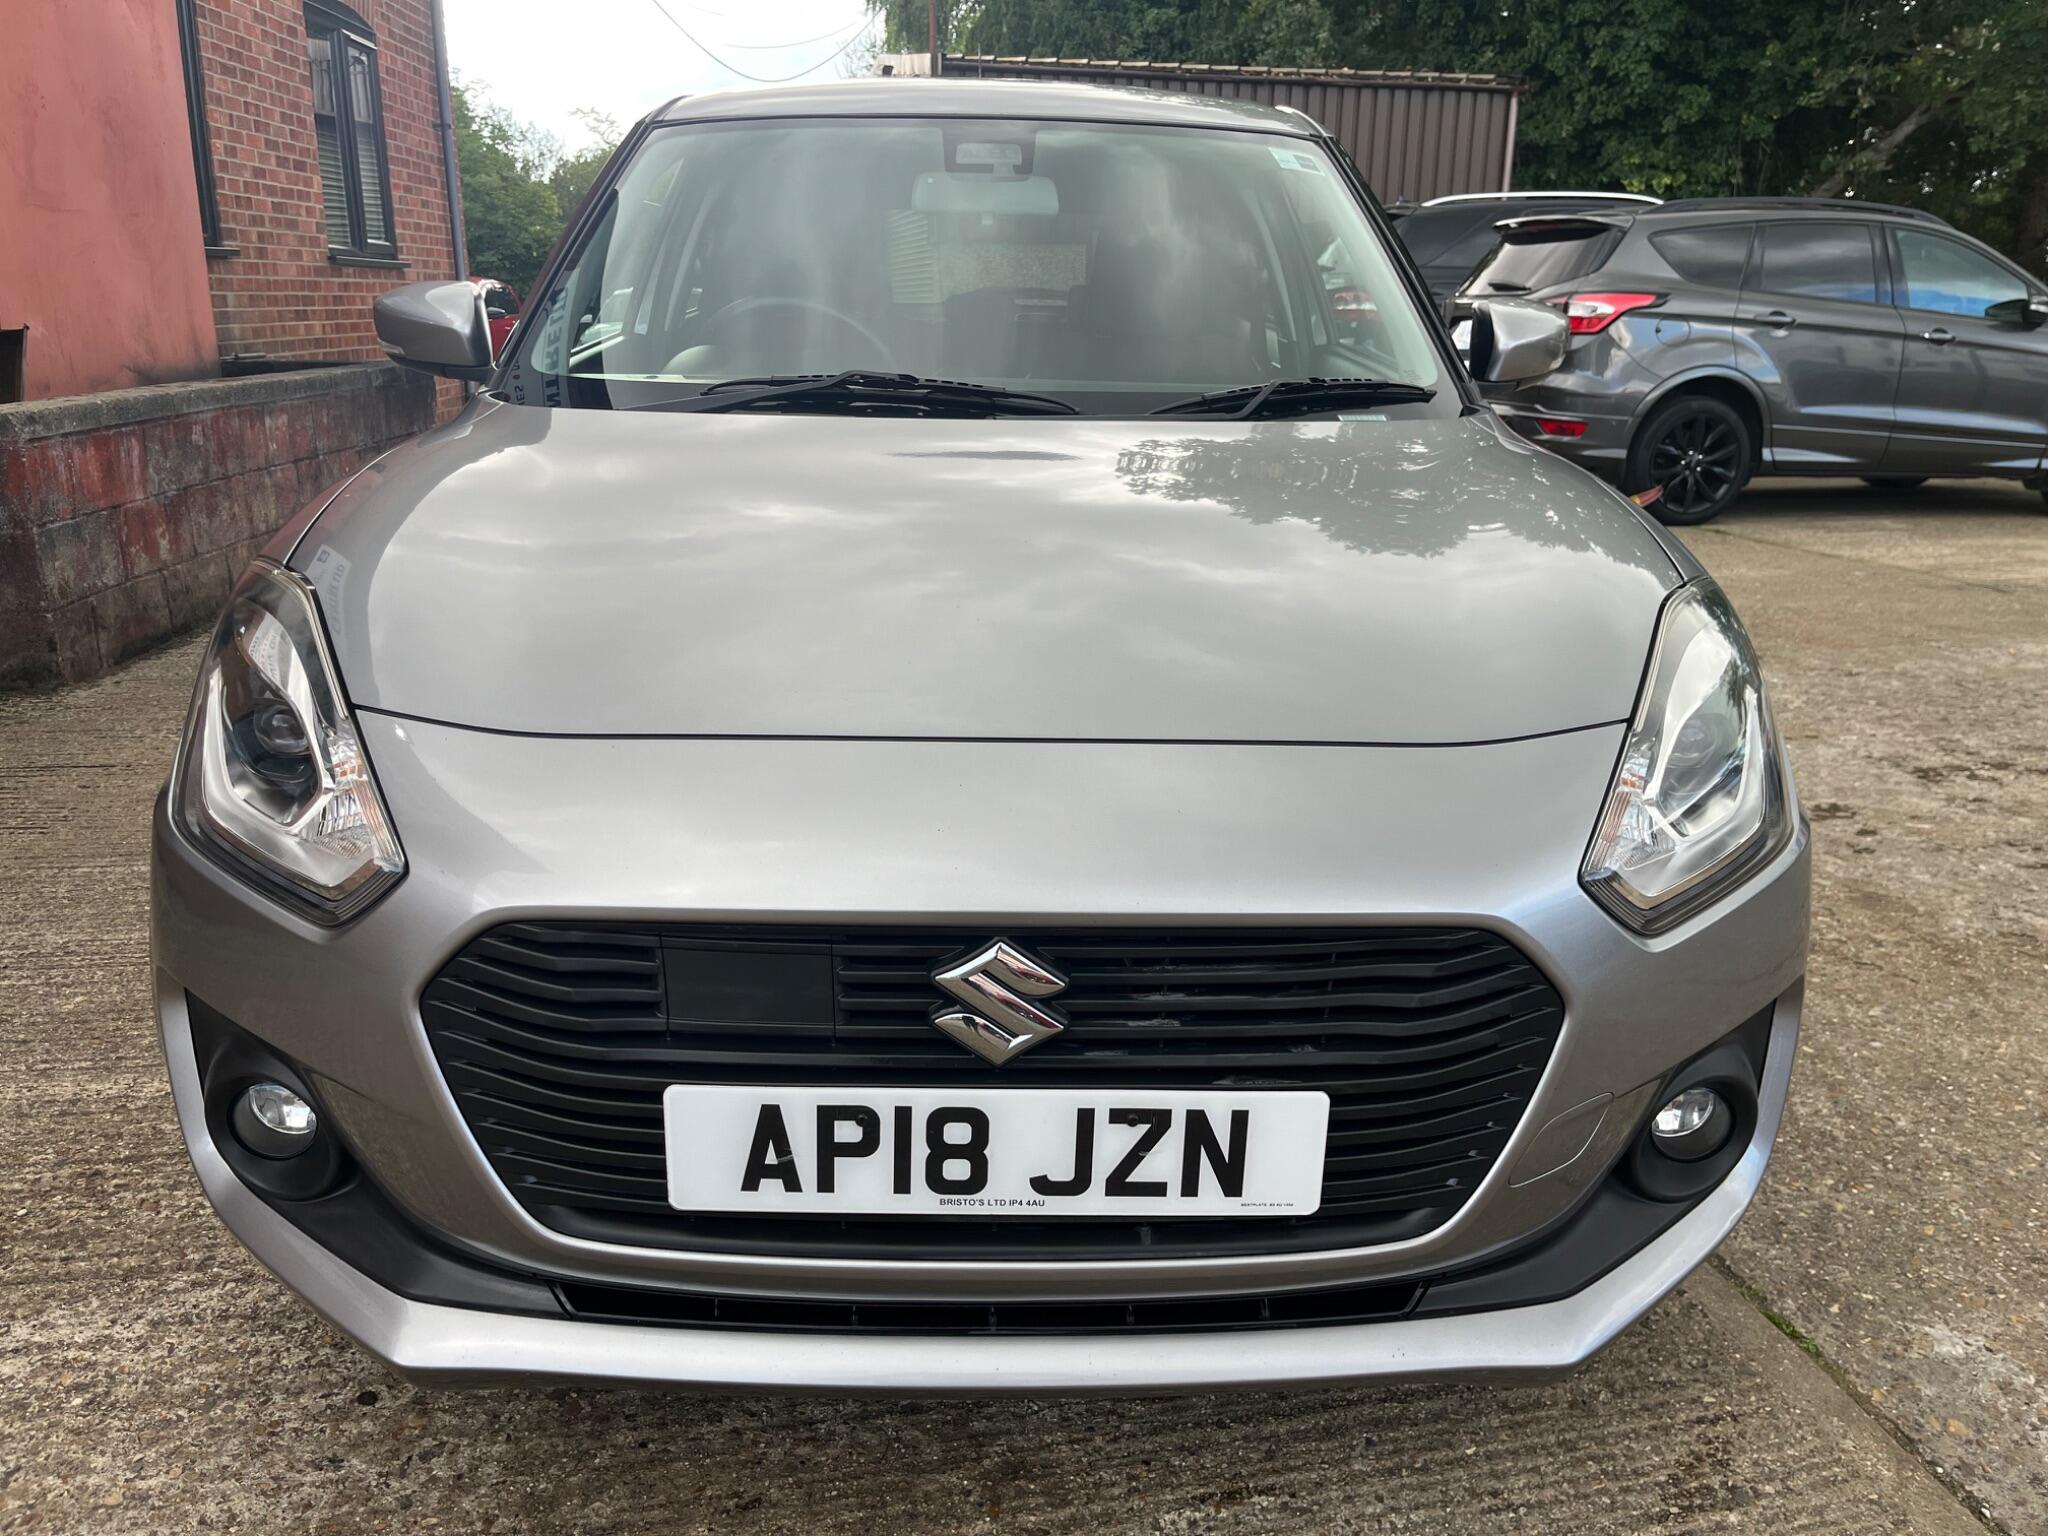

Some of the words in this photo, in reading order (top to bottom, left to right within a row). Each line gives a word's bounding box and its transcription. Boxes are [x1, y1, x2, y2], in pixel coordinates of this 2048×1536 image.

[741, 1103, 989, 1196] AP18
[1030, 1107, 1250, 1198] JZN
[939, 1198, 985, 1207] BRISTO'S
[987, 1198, 1007, 1207] LTD
[1008, 1199, 1023, 1207] IP4
[1025, 1199, 1046, 1208] 4AU
